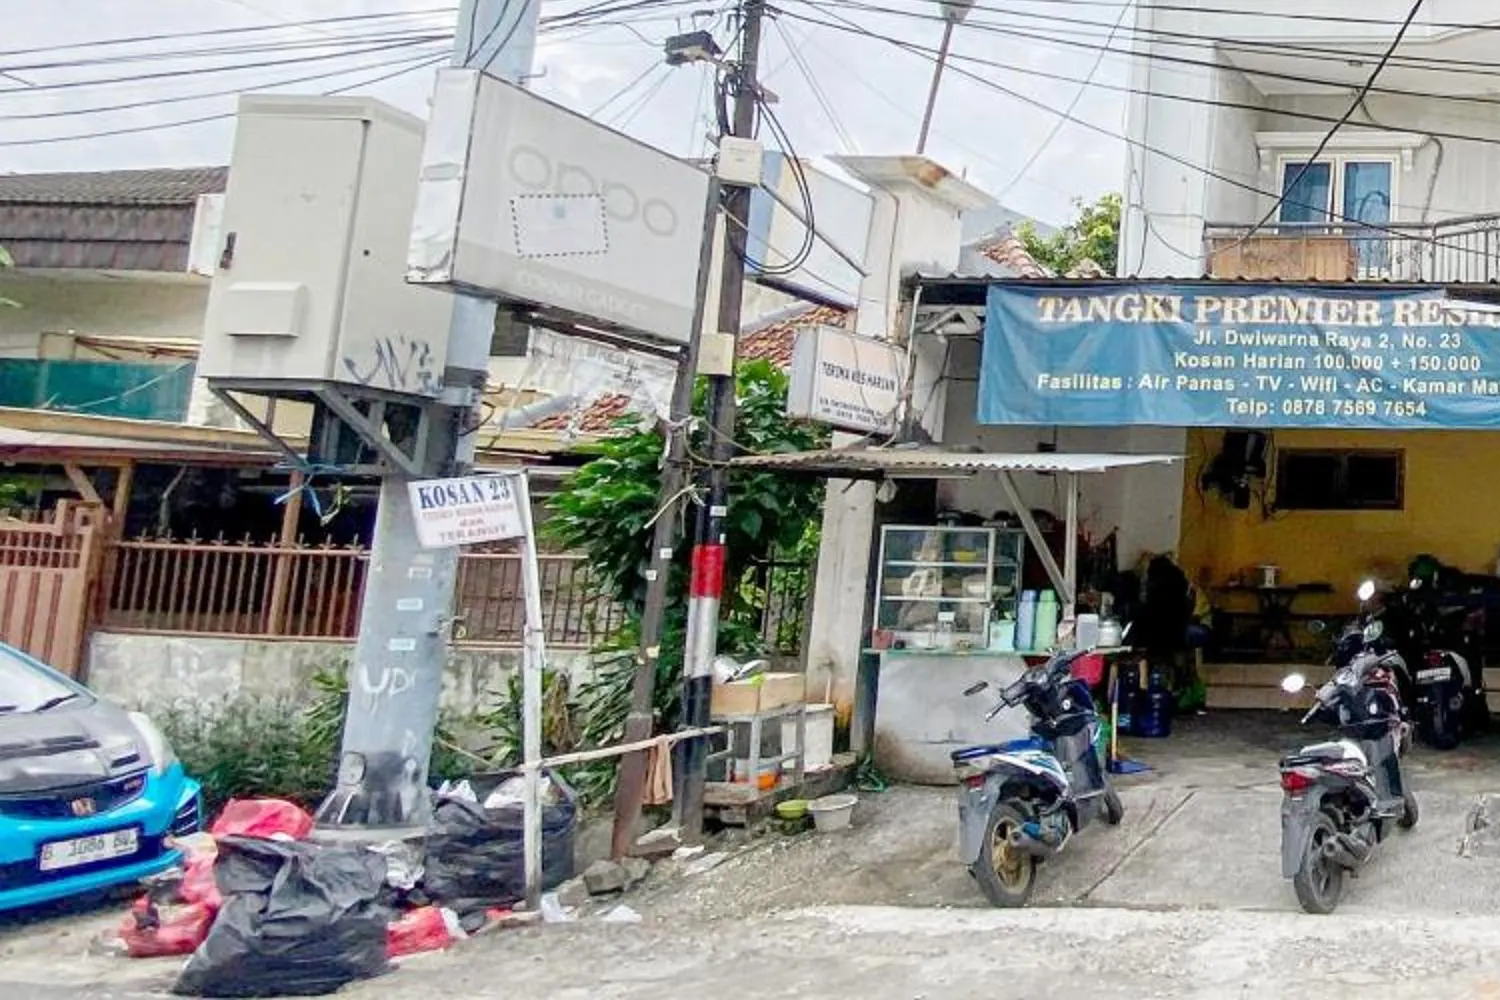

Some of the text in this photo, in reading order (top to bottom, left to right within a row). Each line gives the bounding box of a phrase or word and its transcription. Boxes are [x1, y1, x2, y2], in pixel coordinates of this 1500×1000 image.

[1037, 294, 1184, 323] TANGKI
[1194, 296, 1382, 325] PREMIER
[1193, 329, 1462, 351] Jl. Dwiwarna Raya 2, No. 23
[1174, 351, 1235, 368] Kosan
[1243, 353, 1305, 369] Harian
[1313, 354, 1384, 371] 100.000
[1408, 356, 1481, 372] 150.000
[1036, 374, 1122, 391] Fasilitas
[1138, 374, 1169, 391] Air
[1176, 375, 1236, 392] Panas
[1256, 375, 1283, 391] TV
[1301, 376, 1338, 393] Wifi
[1356, 378, 1383, 393] AC
[1402, 378, 1465, 394] Kamar
[1226, 398, 1275, 418] Telp:
[1282, 399, 1326, 416] 0878
[1383, 401, 1426, 417] 7654
[418, 478, 511, 509] KOSAN 23
